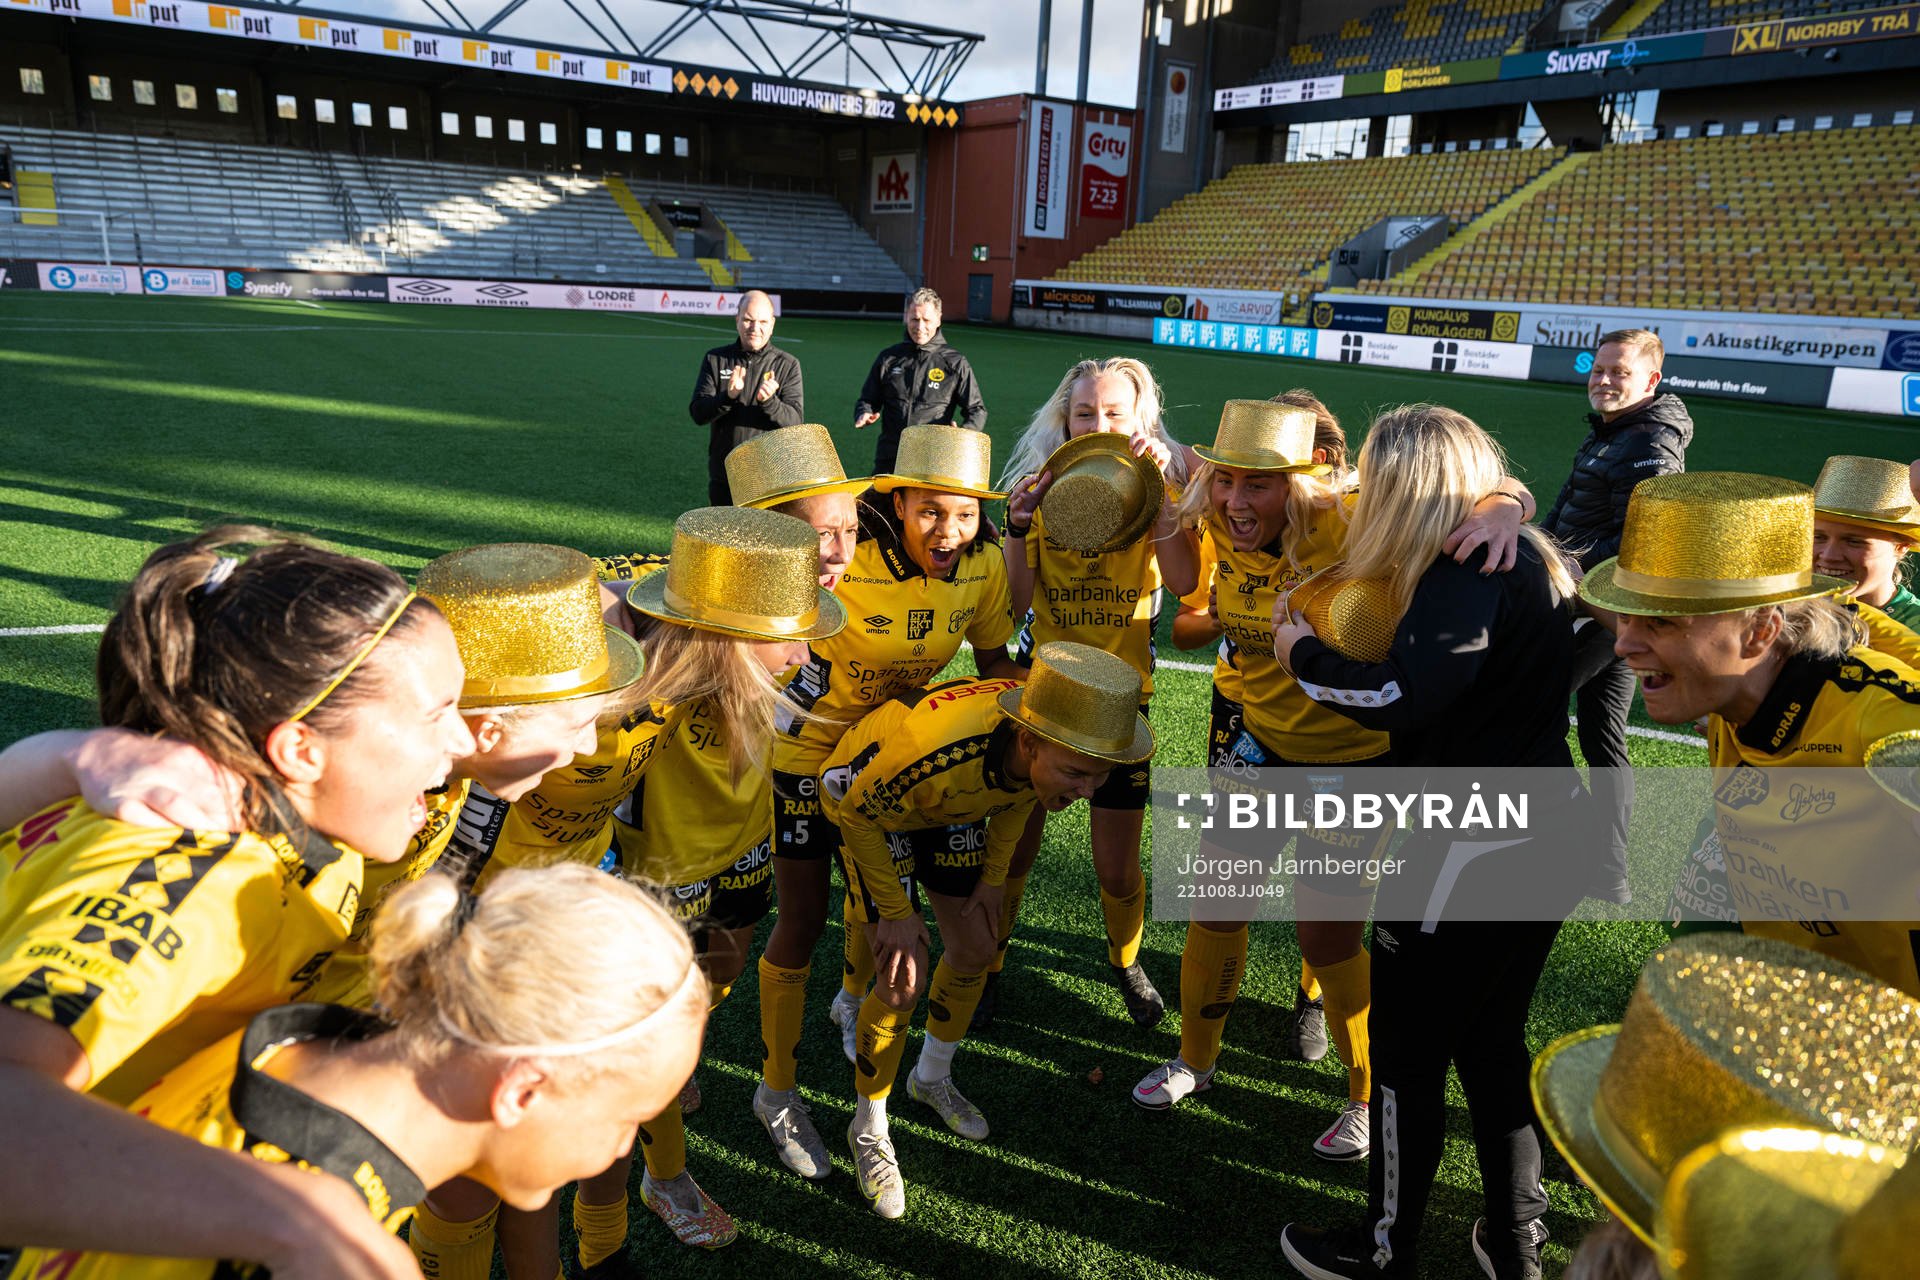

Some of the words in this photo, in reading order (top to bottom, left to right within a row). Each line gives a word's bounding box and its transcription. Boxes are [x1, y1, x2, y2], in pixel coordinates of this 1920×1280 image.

[1736, 25, 1777, 51] XL
[1785, 18, 1865, 43] NORRBY
[1871, 10, 1910, 32] TRÄ
[1546, 49, 1611, 75] SILVENT
[752, 81, 863, 115] HUVUDPARTNERS
[865, 98, 895, 119] 2022
[1088, 132, 1126, 159] City
[1089, 187, 1118, 204] 7-23
[244, 280, 293, 298] Syncify
[587, 289, 636, 302] LONDRÉ
[1414, 306, 1470, 323] KUNGÄLVS
[1411, 323, 1487, 340] RÖRLÄGGERI
[1534, 319, 1602, 348] Sand
[1367, 341, 1399, 352] Bostäder
[1463, 348, 1500, 360] Bostäder
[1702, 332, 1877, 359] Akustikgruppen
[928, 381, 940, 390] JC
[1698, 378, 1720, 391] with
[1722, 380, 1740, 392] the
[1741, 382, 1768, 395] flow
[1634, 458, 1666, 468] umbro
[886, 547, 905, 576] BORÅS
[851, 577, 893, 585] RO-GRUPPEN
[909, 611, 930, 620] EFF
[909, 620, 931, 629] EKT
[1226, 611, 1260, 622] TOVEKS
[866, 627, 890, 635] umbro
[908, 628, 921, 639] IV
[1223, 622, 1277, 643] arban
[1771, 702, 1802, 748] BORÅS
[1213, 773, 1273, 802] MIRENT
[795, 820, 809, 844] 5
[949, 828, 988, 850] ello
[734, 842, 771, 872] ello
[674, 876, 711, 900] ello
[718, 864, 771, 890] RAMIR
[1681, 863, 1728, 901] ellos
[1722, 843, 1850, 911] banken
[70, 896, 184, 961] IBAB
[1215, 955, 1238, 1002] VINNERGI
